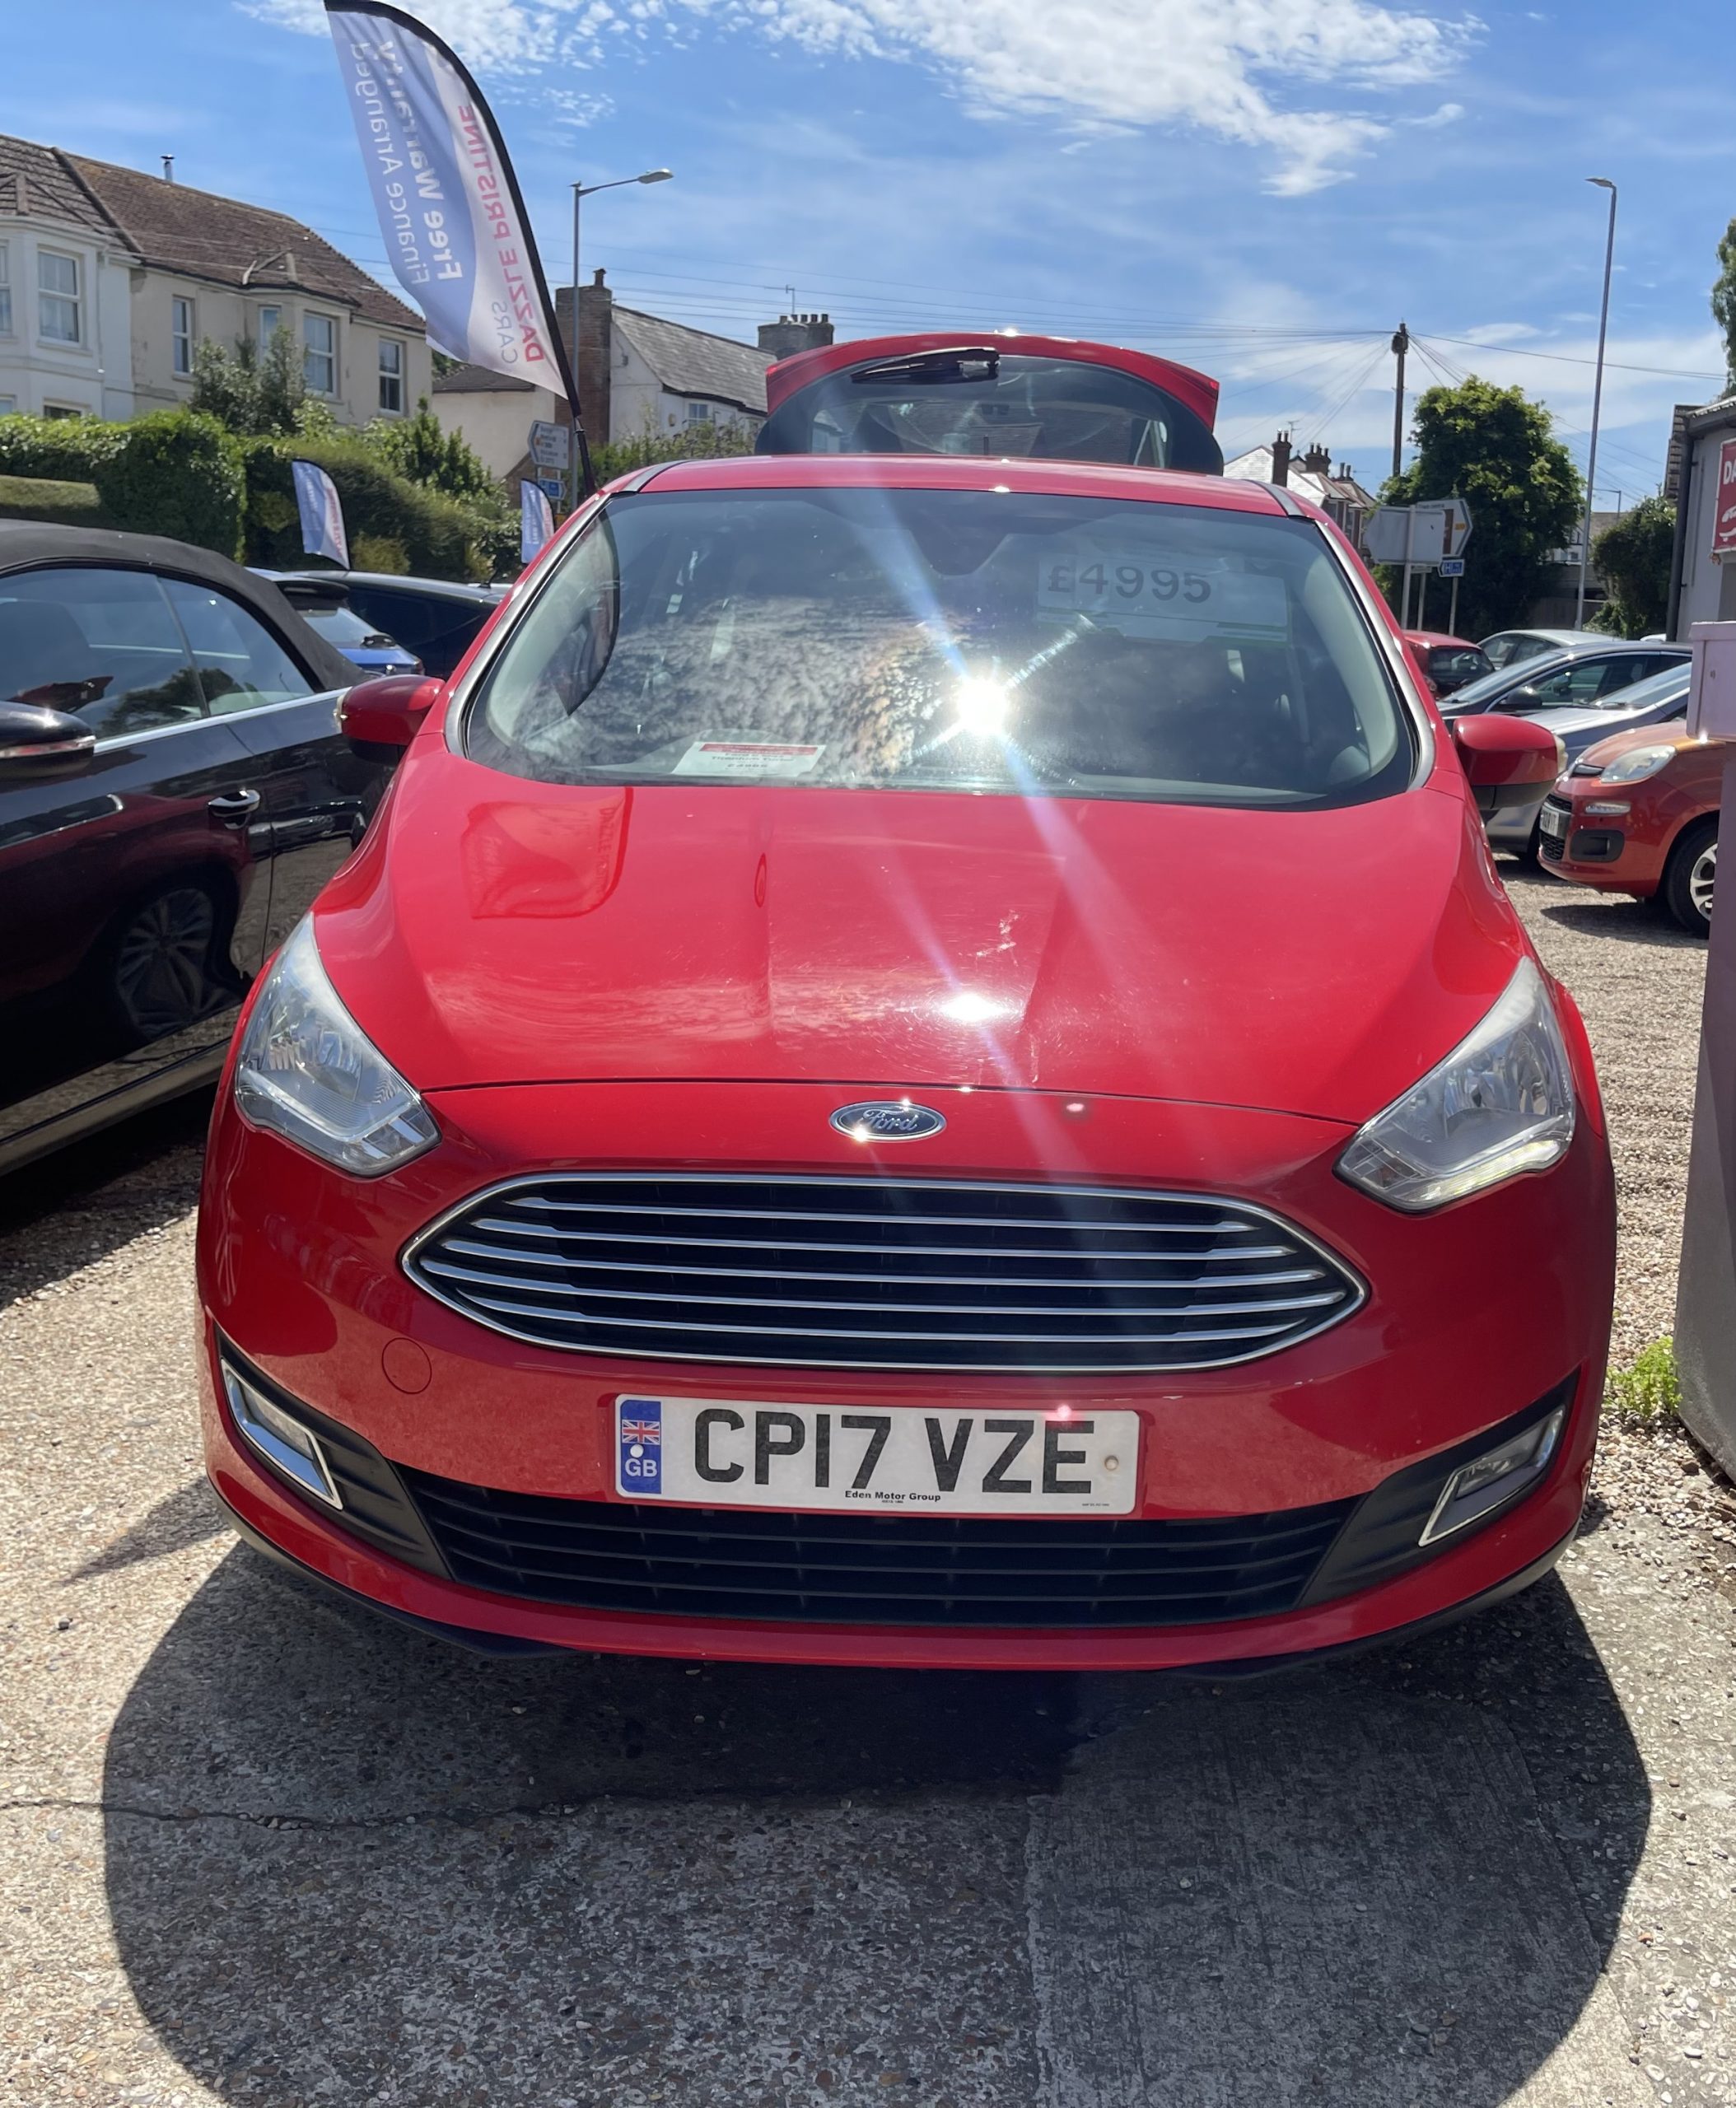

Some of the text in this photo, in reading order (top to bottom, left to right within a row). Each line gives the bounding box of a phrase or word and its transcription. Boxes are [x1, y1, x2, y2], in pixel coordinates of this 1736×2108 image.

[1047, 562, 1211, 604] £4995
[856, 1108, 920, 1132] Ford
[695, 1407, 1095, 1495] CP17 VZE
[624, 1457, 658, 1478] GB
[844, 1490, 872, 1499] Eden
[875, 1491, 906, 1501] Motor
[908, 1492, 941, 1503] Group
